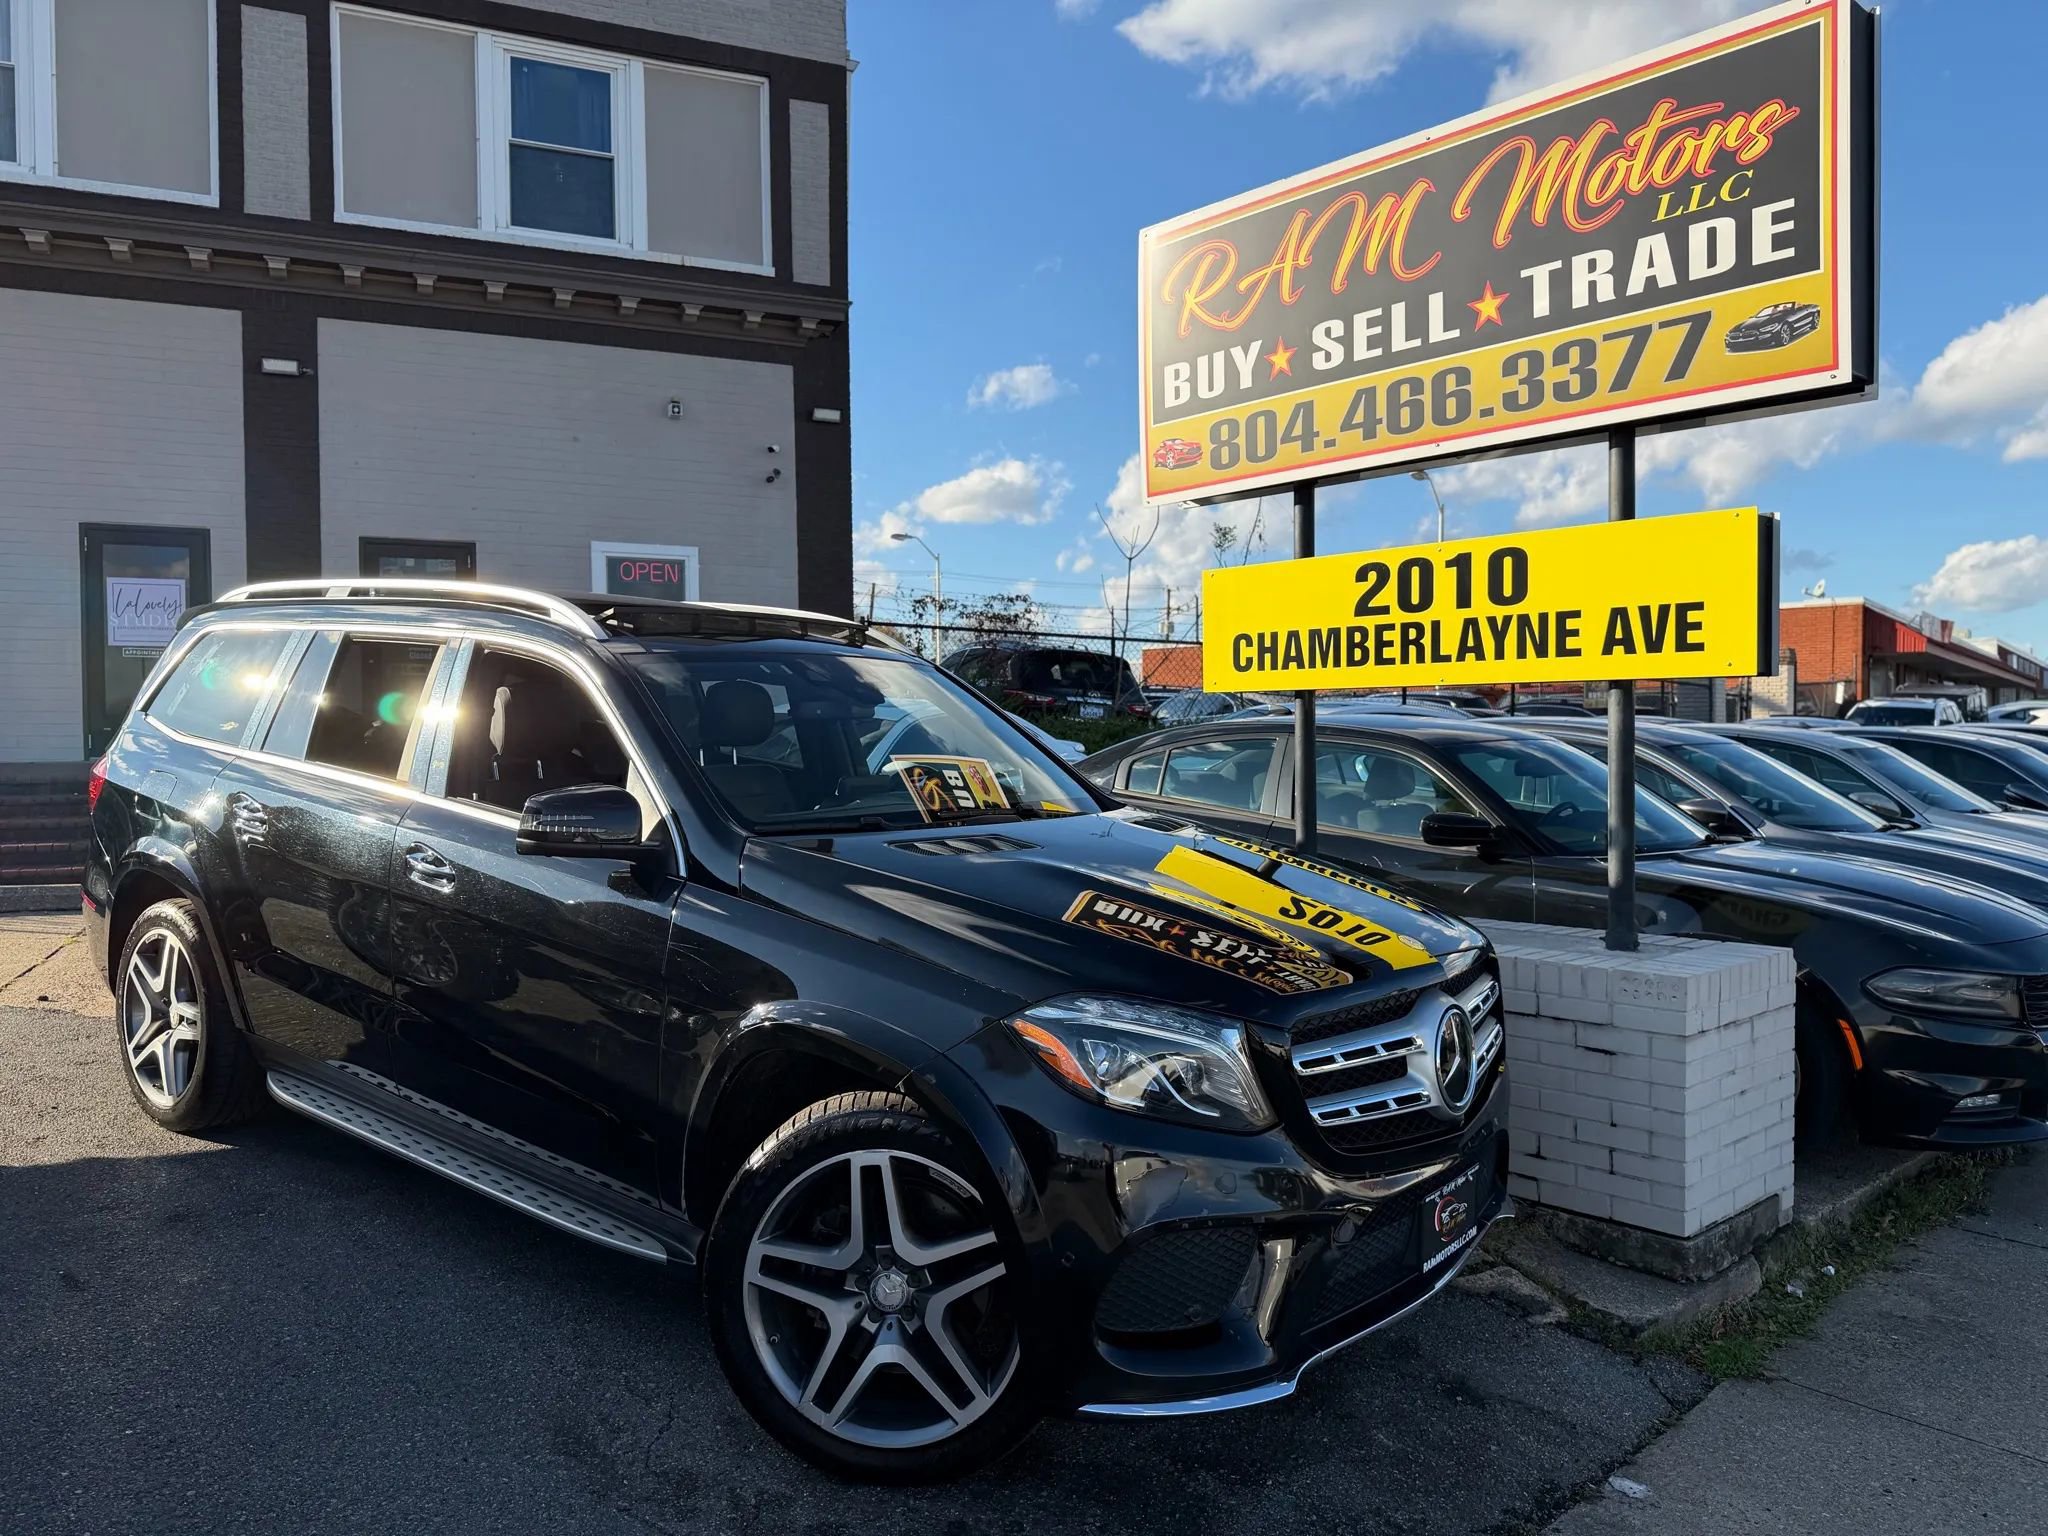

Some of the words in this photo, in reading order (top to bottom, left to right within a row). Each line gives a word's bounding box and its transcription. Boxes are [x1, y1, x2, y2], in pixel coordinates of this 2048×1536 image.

[1162, 177, 1441, 338] RAM
[1450, 96, 1801, 250] Motors
[1653, 169, 1755, 222] LLC
[1163, 340, 1263, 409] BUY
[1311, 290, 1460, 371] SELL
[1520, 197, 1797, 319] TRADE
[1209, 310, 1713, 472] 804.466.3377
[620, 561, 679, 583] OPEN
[1353, 546, 1529, 617] 2010
[1231, 609, 1582, 673] CHAMBERLAYNE
[1600, 601, 1706, 656] AVE
